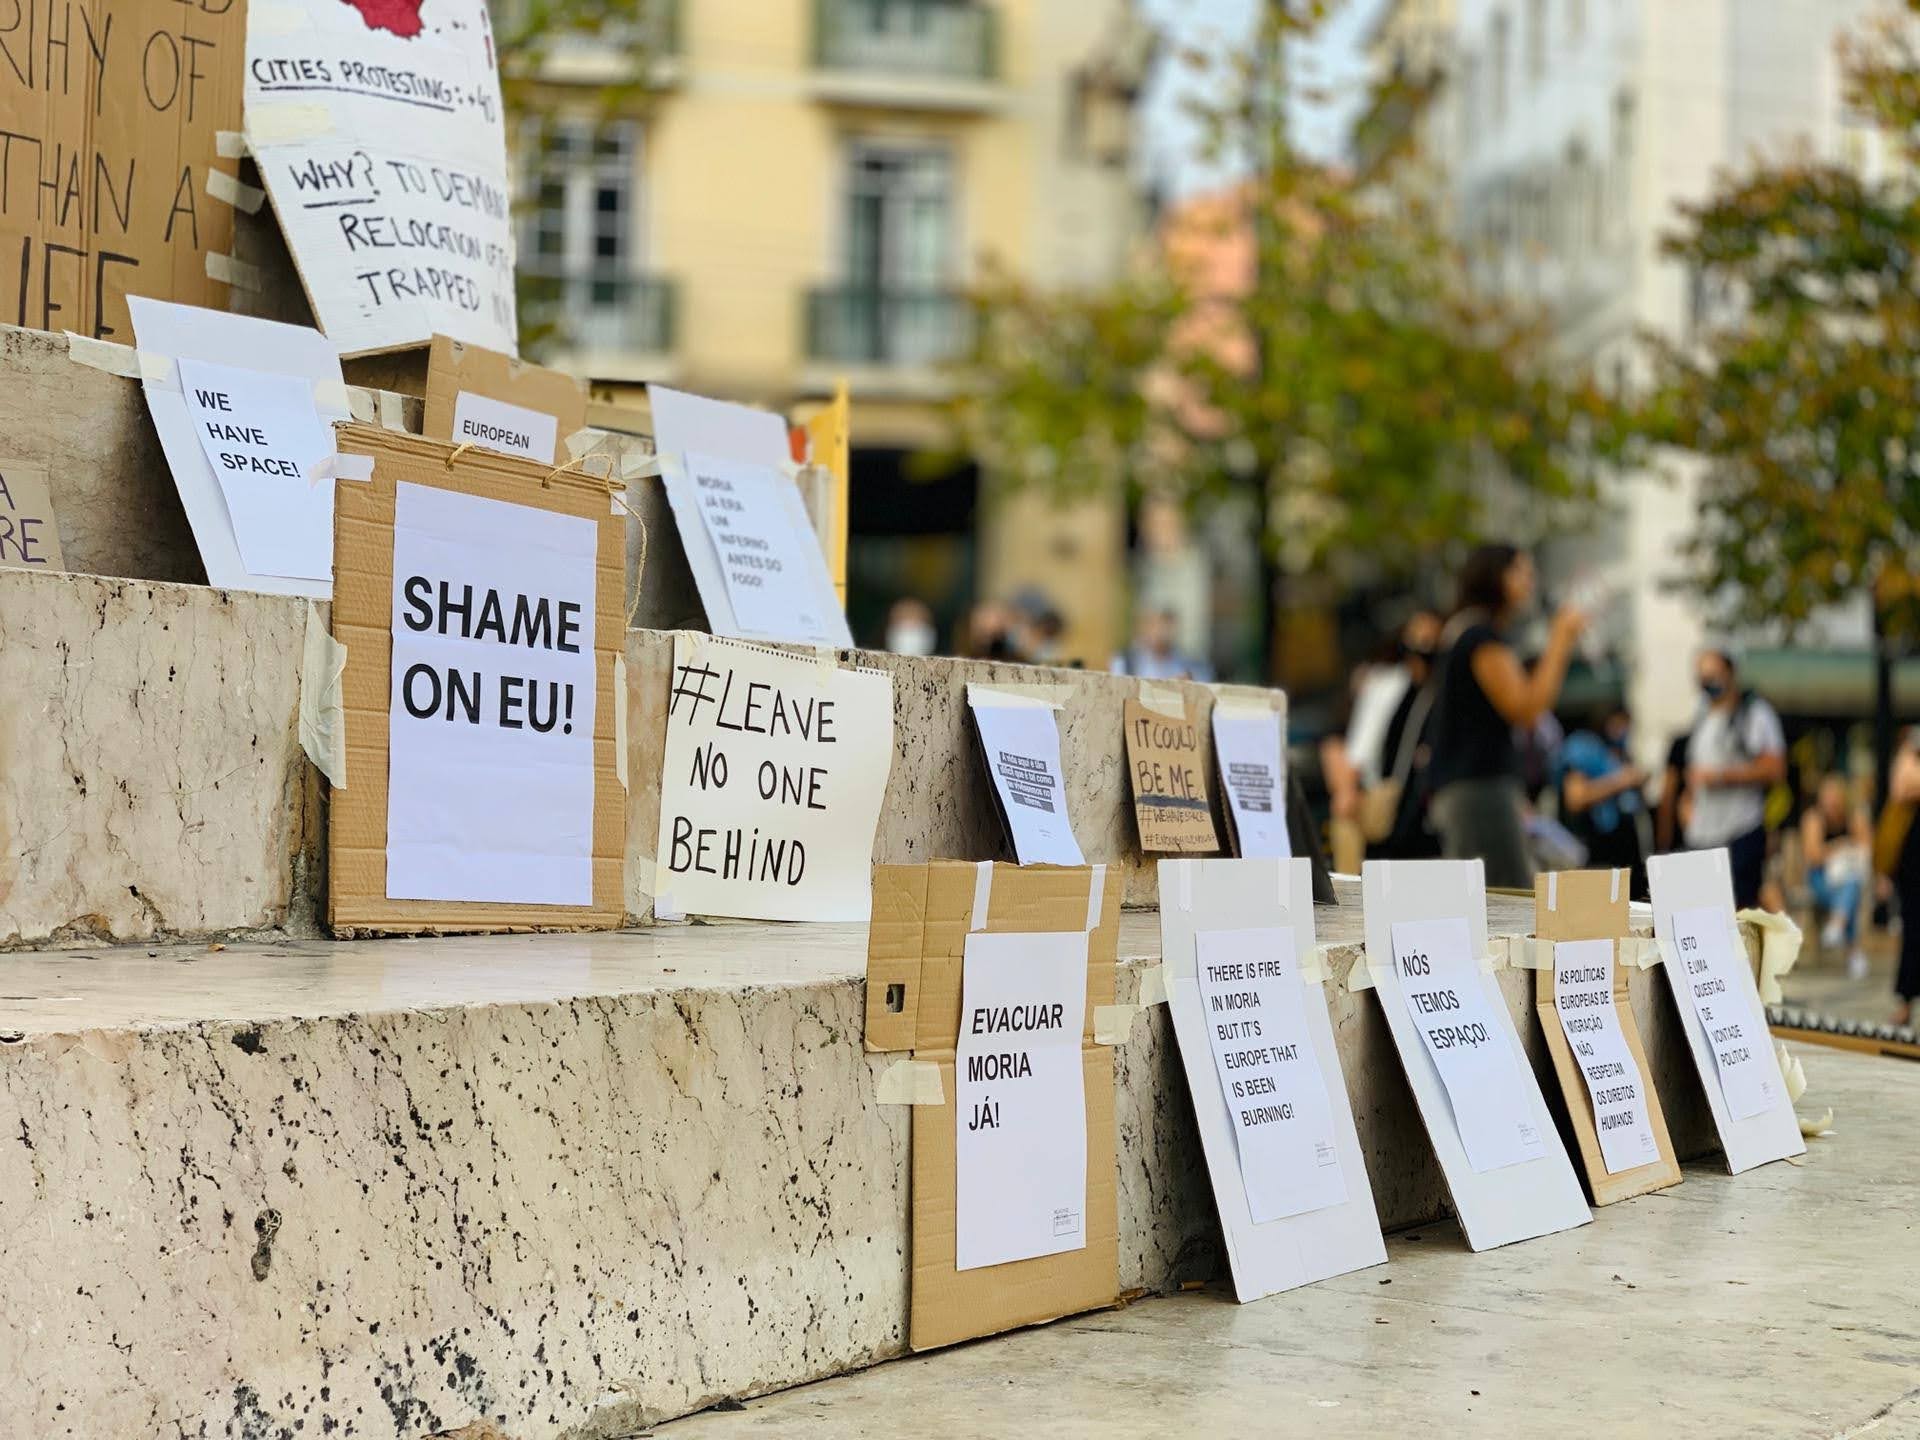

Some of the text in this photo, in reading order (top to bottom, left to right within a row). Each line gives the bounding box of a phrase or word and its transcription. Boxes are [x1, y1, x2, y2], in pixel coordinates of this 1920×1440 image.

[143, 30, 216, 123] OF
[252, 58, 332, 84] CITIES
[339, 60, 464, 105] PROTESTING:
[289, 151, 381, 196] WHY?
[386, 160, 427, 193] TO
[0, 130, 198, 250] THAN A
[339, 214, 482, 261] RELOCATION
[356, 267, 481, 312] TRAPPED
[195, 389, 232, 412] WE
[206, 422, 268, 446] HAVE
[463, 419, 530, 449] EUROPEAN
[219, 452, 301, 479] SPACE!
[403, 575, 581, 654] SHAME
[402, 663, 574, 735] ON EU!
[670, 662, 837, 743] #LEAVE
[1135, 719, 1197, 752] IT COULD
[689, 741, 829, 811] NO ONE
[1137, 760, 1164, 793] BE
[1680, 936, 1697, 951] ISTO
[1207, 960, 1282, 983] THERE IS FIRE
[1402, 949, 1431, 977] NÓS
[1559, 965, 1606, 985] AS POLÍTICAS
[1693, 958, 1709, 974] UMA
[1560, 990, 1610, 1011] EUROPEIAS DE
[1694, 977, 1726, 998] QUESTÃO
[1211, 991, 1261, 1012] IN MORIA
[1411, 989, 1460, 1015] TEMOS
[971, 1003, 1064, 1035] EVACUAR
[1566, 1014, 1603, 1034] MIGRAÇÃO
[1702, 1008, 1714, 1022] DE
[1217, 1020, 1262, 1041] BUT IT'S
[1428, 1021, 1490, 1050] ESPAÇO!
[1711, 1024, 1743, 1044] VONTADE
[1224, 1044, 1298, 1070] EUROPE THAT
[1576, 1041, 1594, 1057] NÃO
[968, 1052, 1032, 1083] MORIA
[1587, 1062, 1625, 1081] RESPEITAM
[1231, 1076, 1277, 1098] IS BEEN
[1596, 1084, 1635, 1106] OS DIREITOS
[968, 1096, 1000, 1131] JÁ!
[1241, 1103, 1294, 1127] BURNING!
[1601, 1111, 1633, 1131] HUMANOS!
